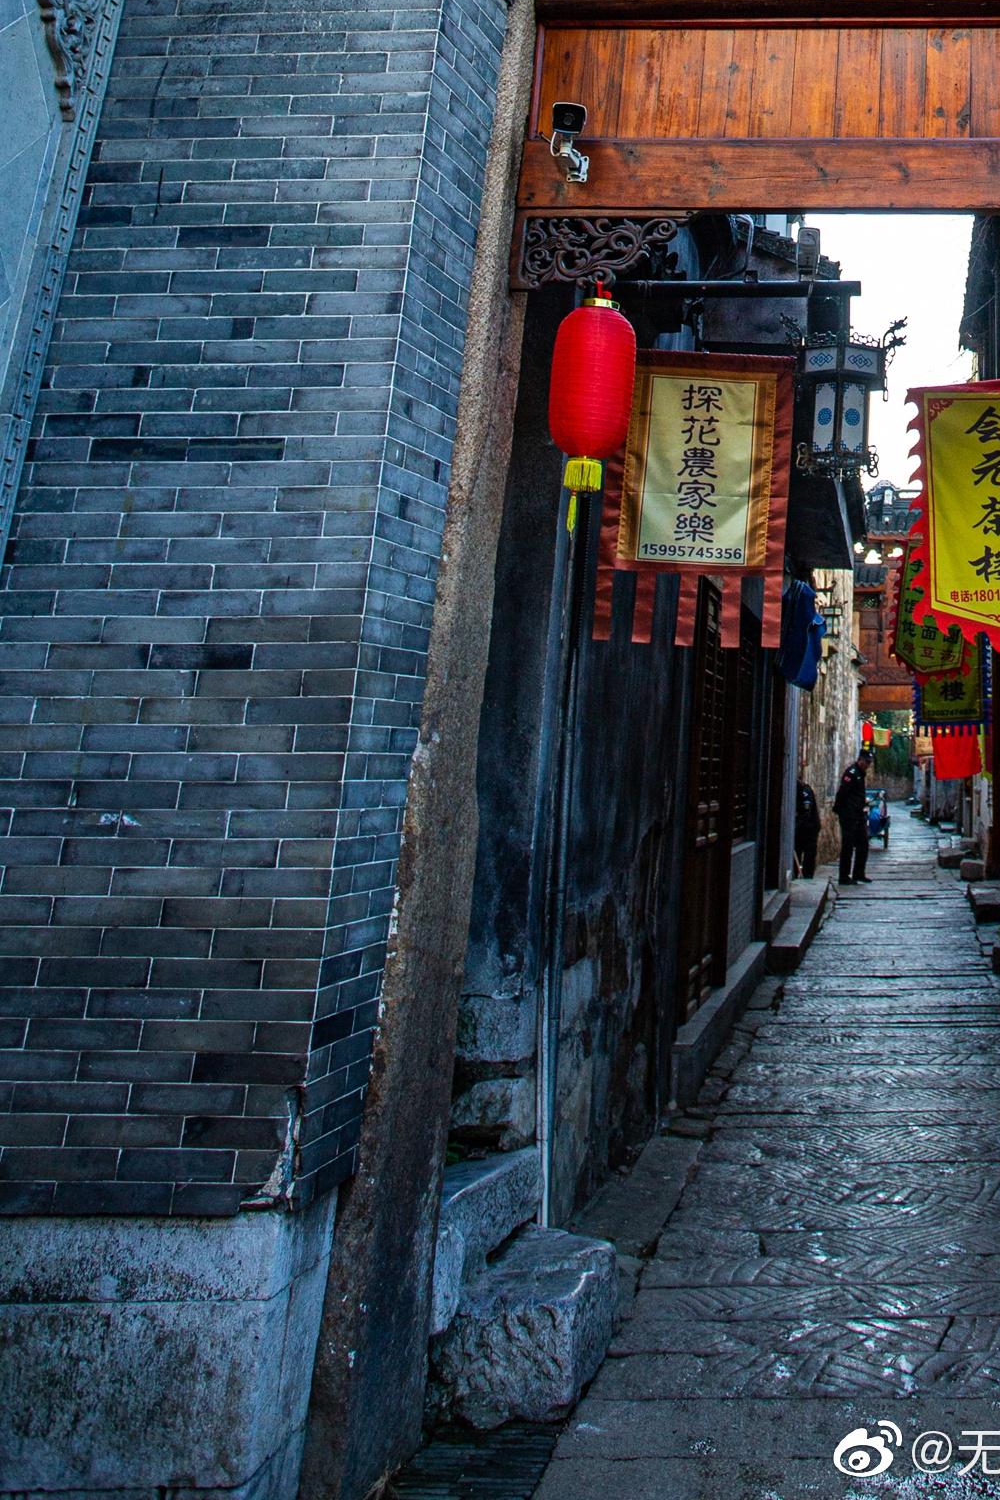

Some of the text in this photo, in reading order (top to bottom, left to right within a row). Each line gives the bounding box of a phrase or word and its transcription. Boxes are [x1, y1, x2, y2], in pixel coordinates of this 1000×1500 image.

[674, 384, 723, 543] 探花農家樂
[641, 543, 743, 560] 15995745356
